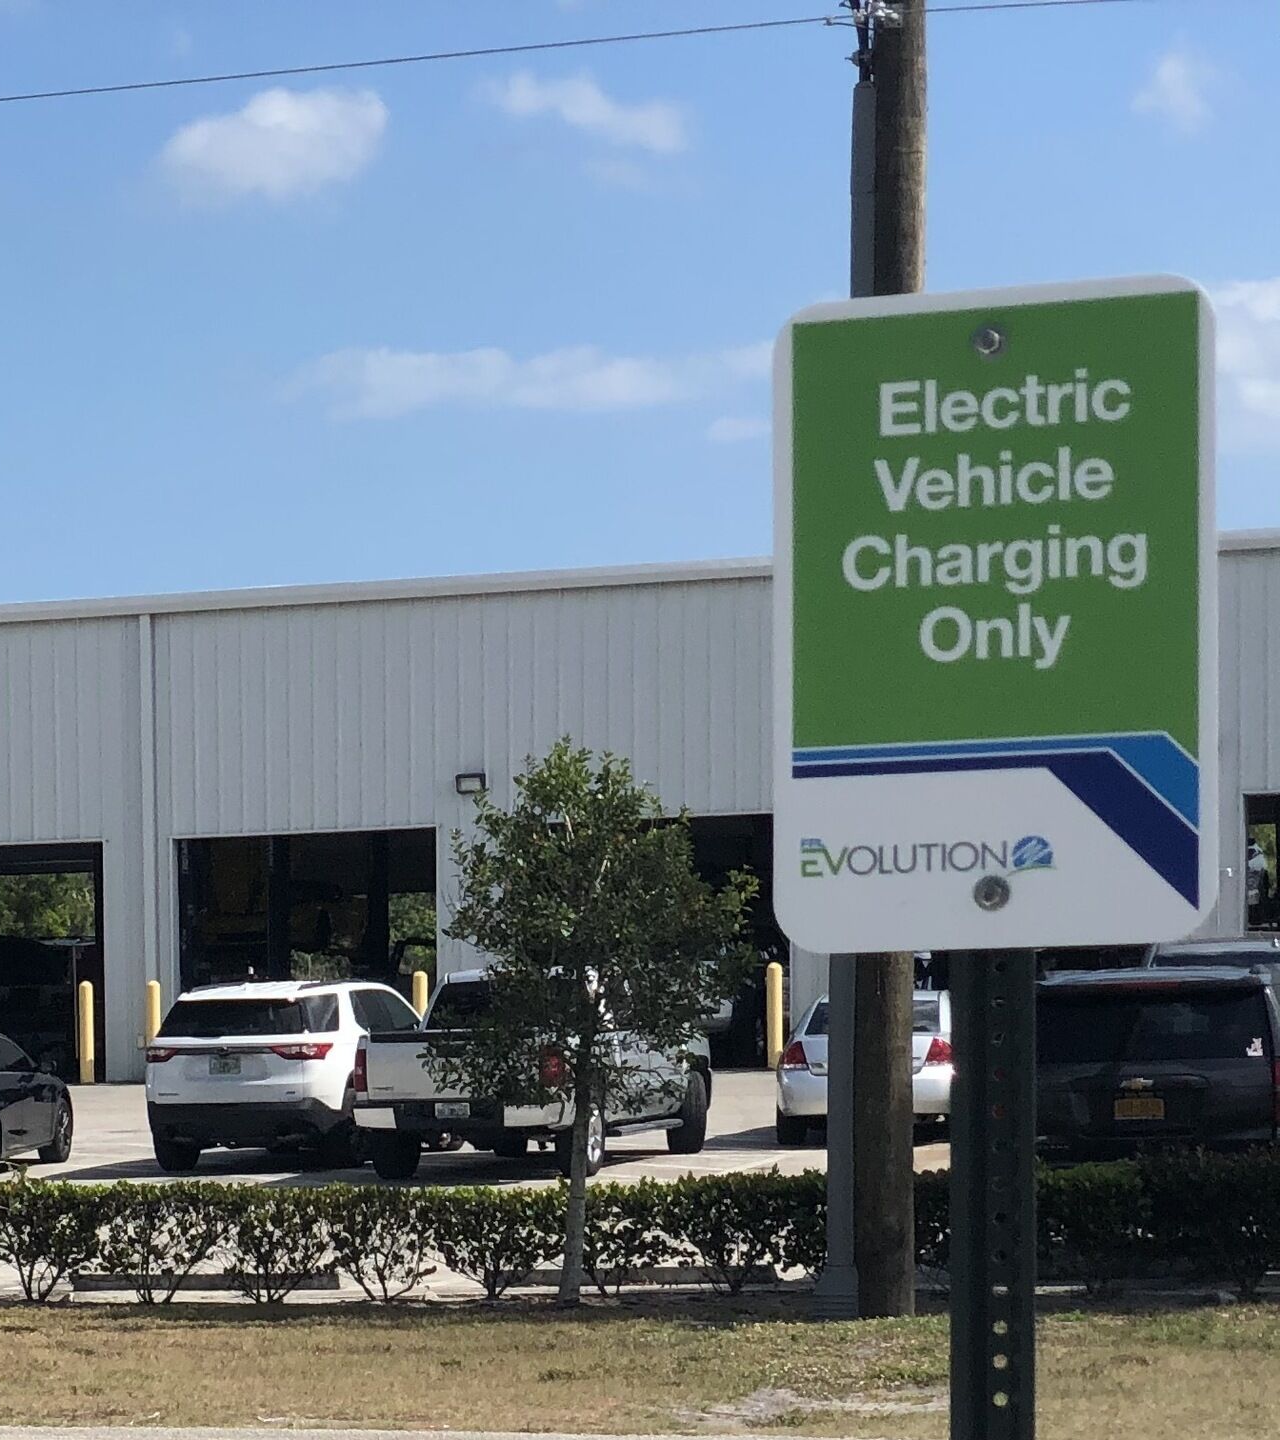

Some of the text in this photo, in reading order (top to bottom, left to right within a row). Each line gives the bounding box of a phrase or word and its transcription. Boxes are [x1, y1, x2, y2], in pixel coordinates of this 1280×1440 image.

[878, 367, 1132, 437] Electric
[873, 445, 1116, 512] Vehicle
[842, 525, 1148, 595] Charging
[920, 603, 1071, 669] Only
[800, 840, 1008, 877] EVOLUTION
